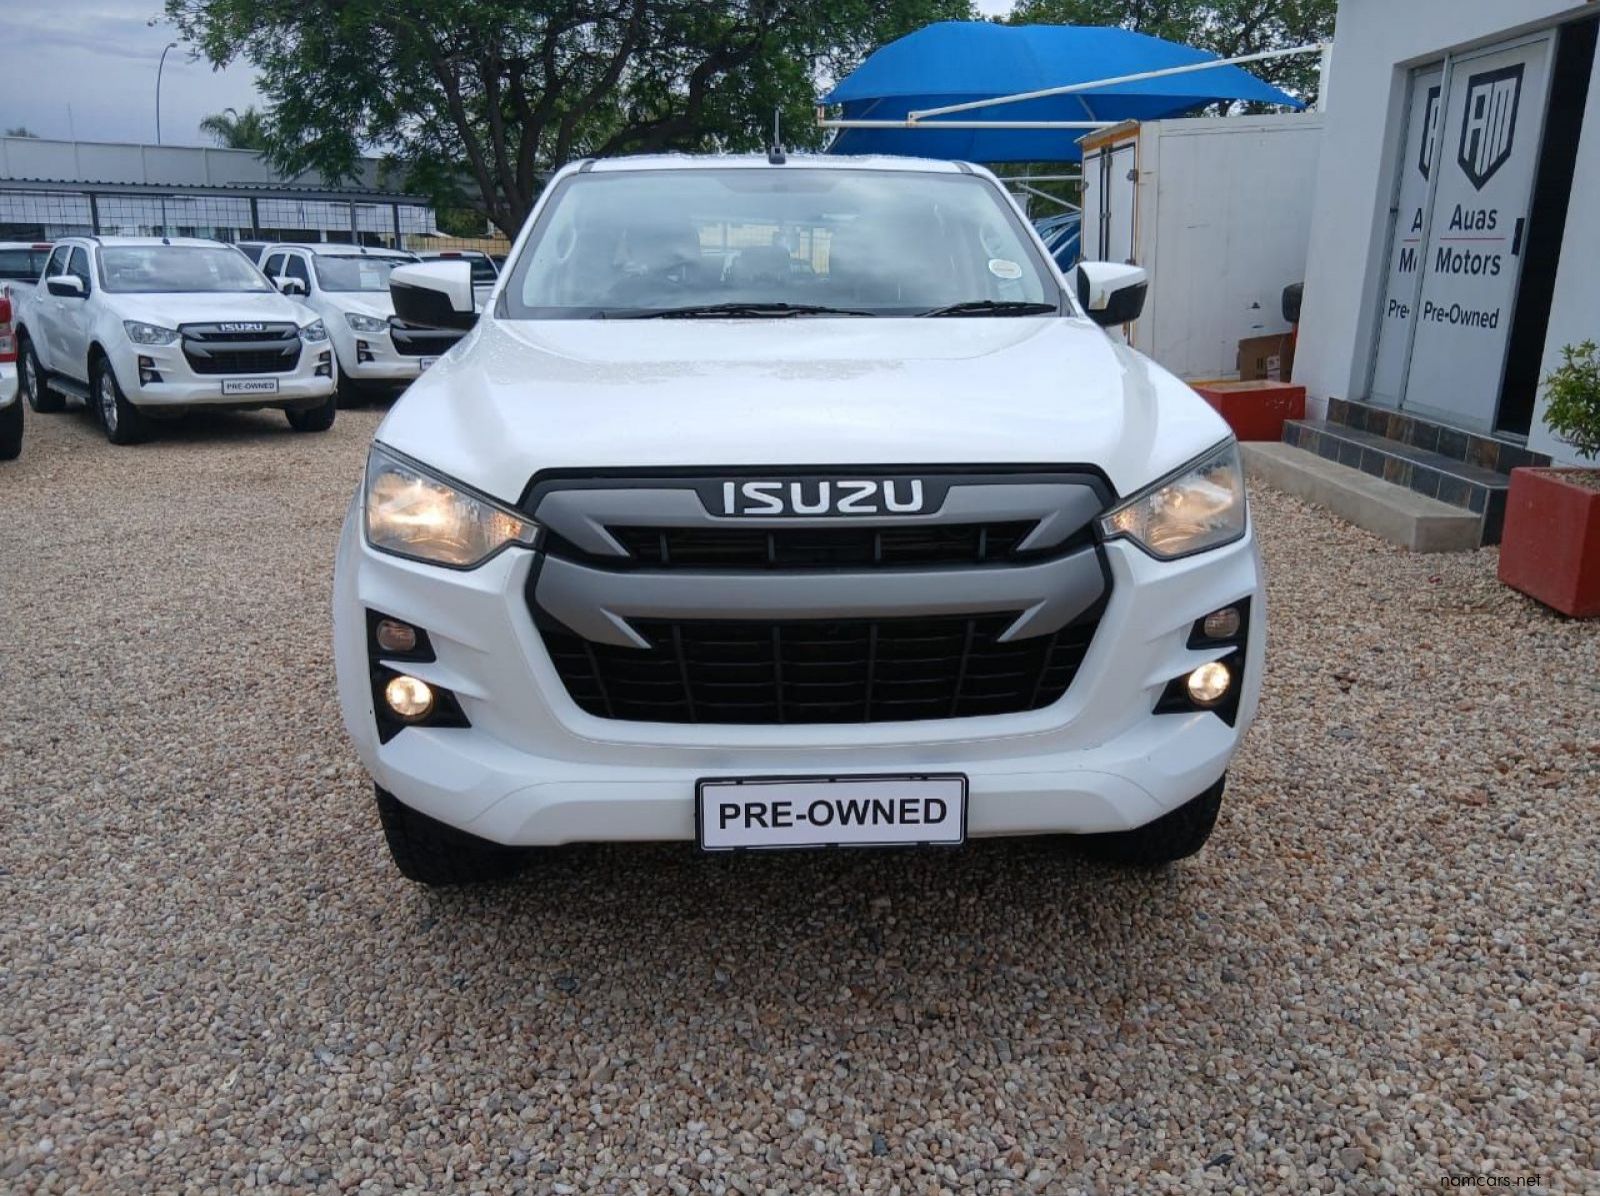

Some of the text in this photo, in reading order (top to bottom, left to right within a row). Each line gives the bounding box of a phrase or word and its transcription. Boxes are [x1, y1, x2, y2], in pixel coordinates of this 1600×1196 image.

[1449, 204, 1498, 231] Auas
[1435, 247, 1501, 276] Motors
[220, 323, 263, 331] ISUZU
[1423, 301, 1500, 329] Pre-Owned
[226, 382, 275, 390] PRE-OWNED
[723, 479, 923, 515] ISUZU
[718, 798, 948, 830] PRE-OWNED
